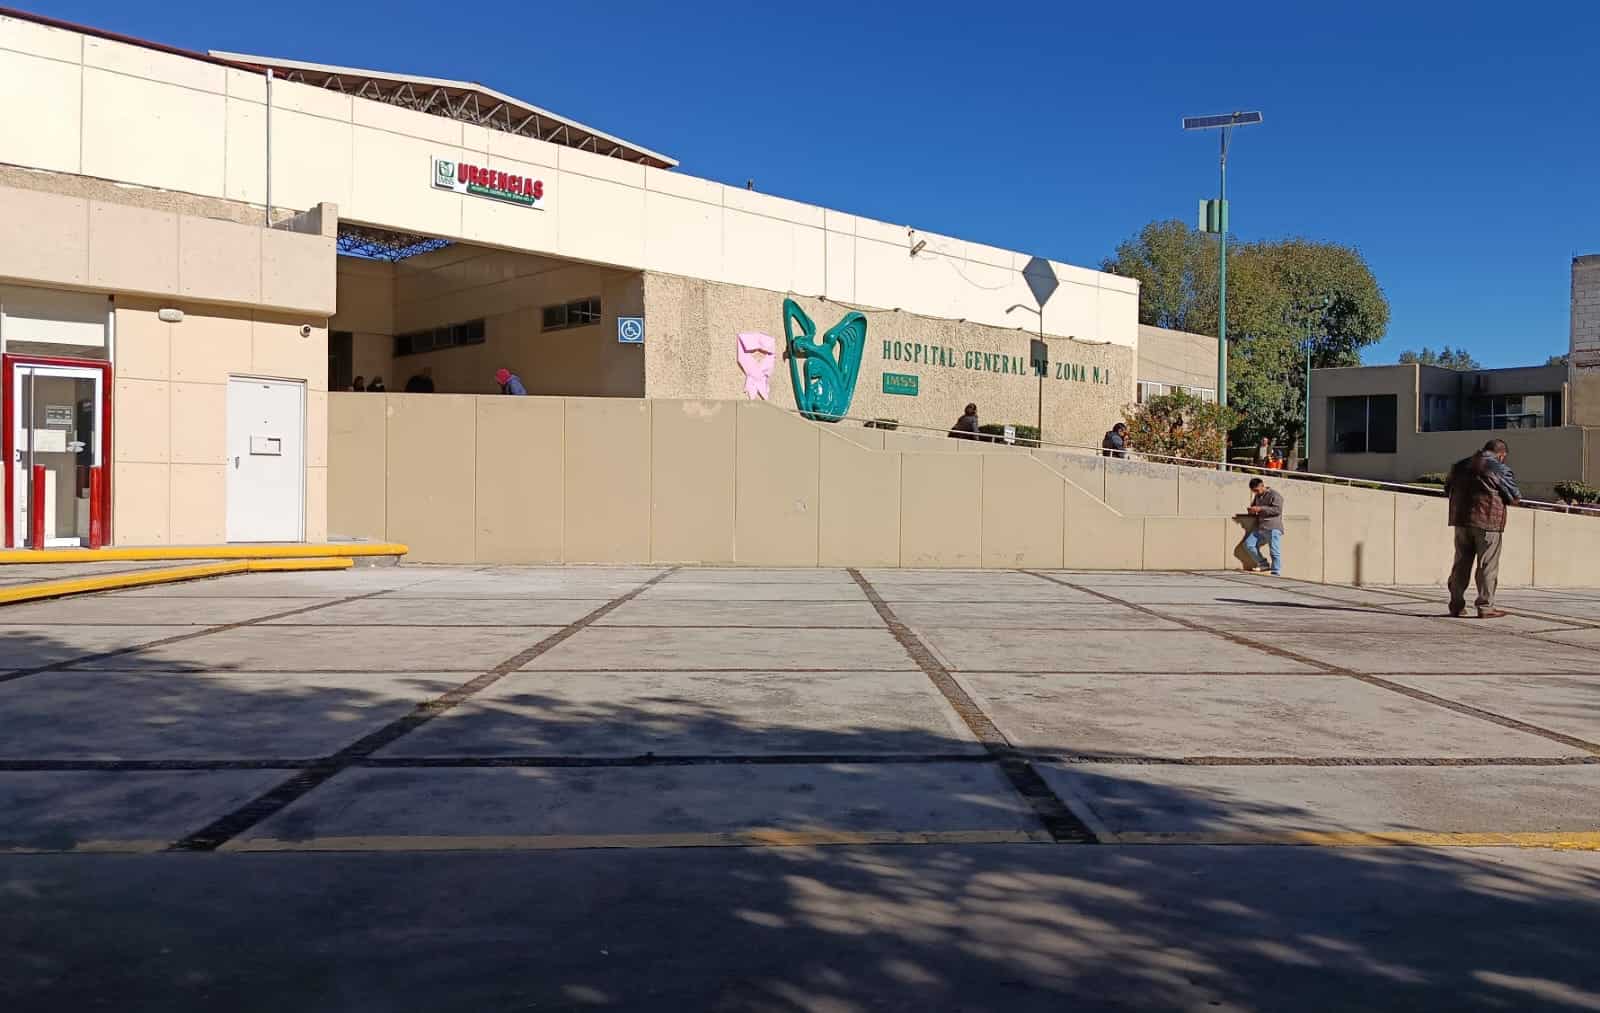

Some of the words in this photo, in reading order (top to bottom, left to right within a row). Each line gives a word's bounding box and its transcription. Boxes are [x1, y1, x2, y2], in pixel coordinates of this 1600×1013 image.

[458, 162, 544, 200] URGENCIAS
[883, 340, 956, 368] HOSPITAL
[965, 351, 1026, 376] GENERAL
[1034, 359, 1048, 378] DE
[1056, 362, 1086, 382] ZONA
